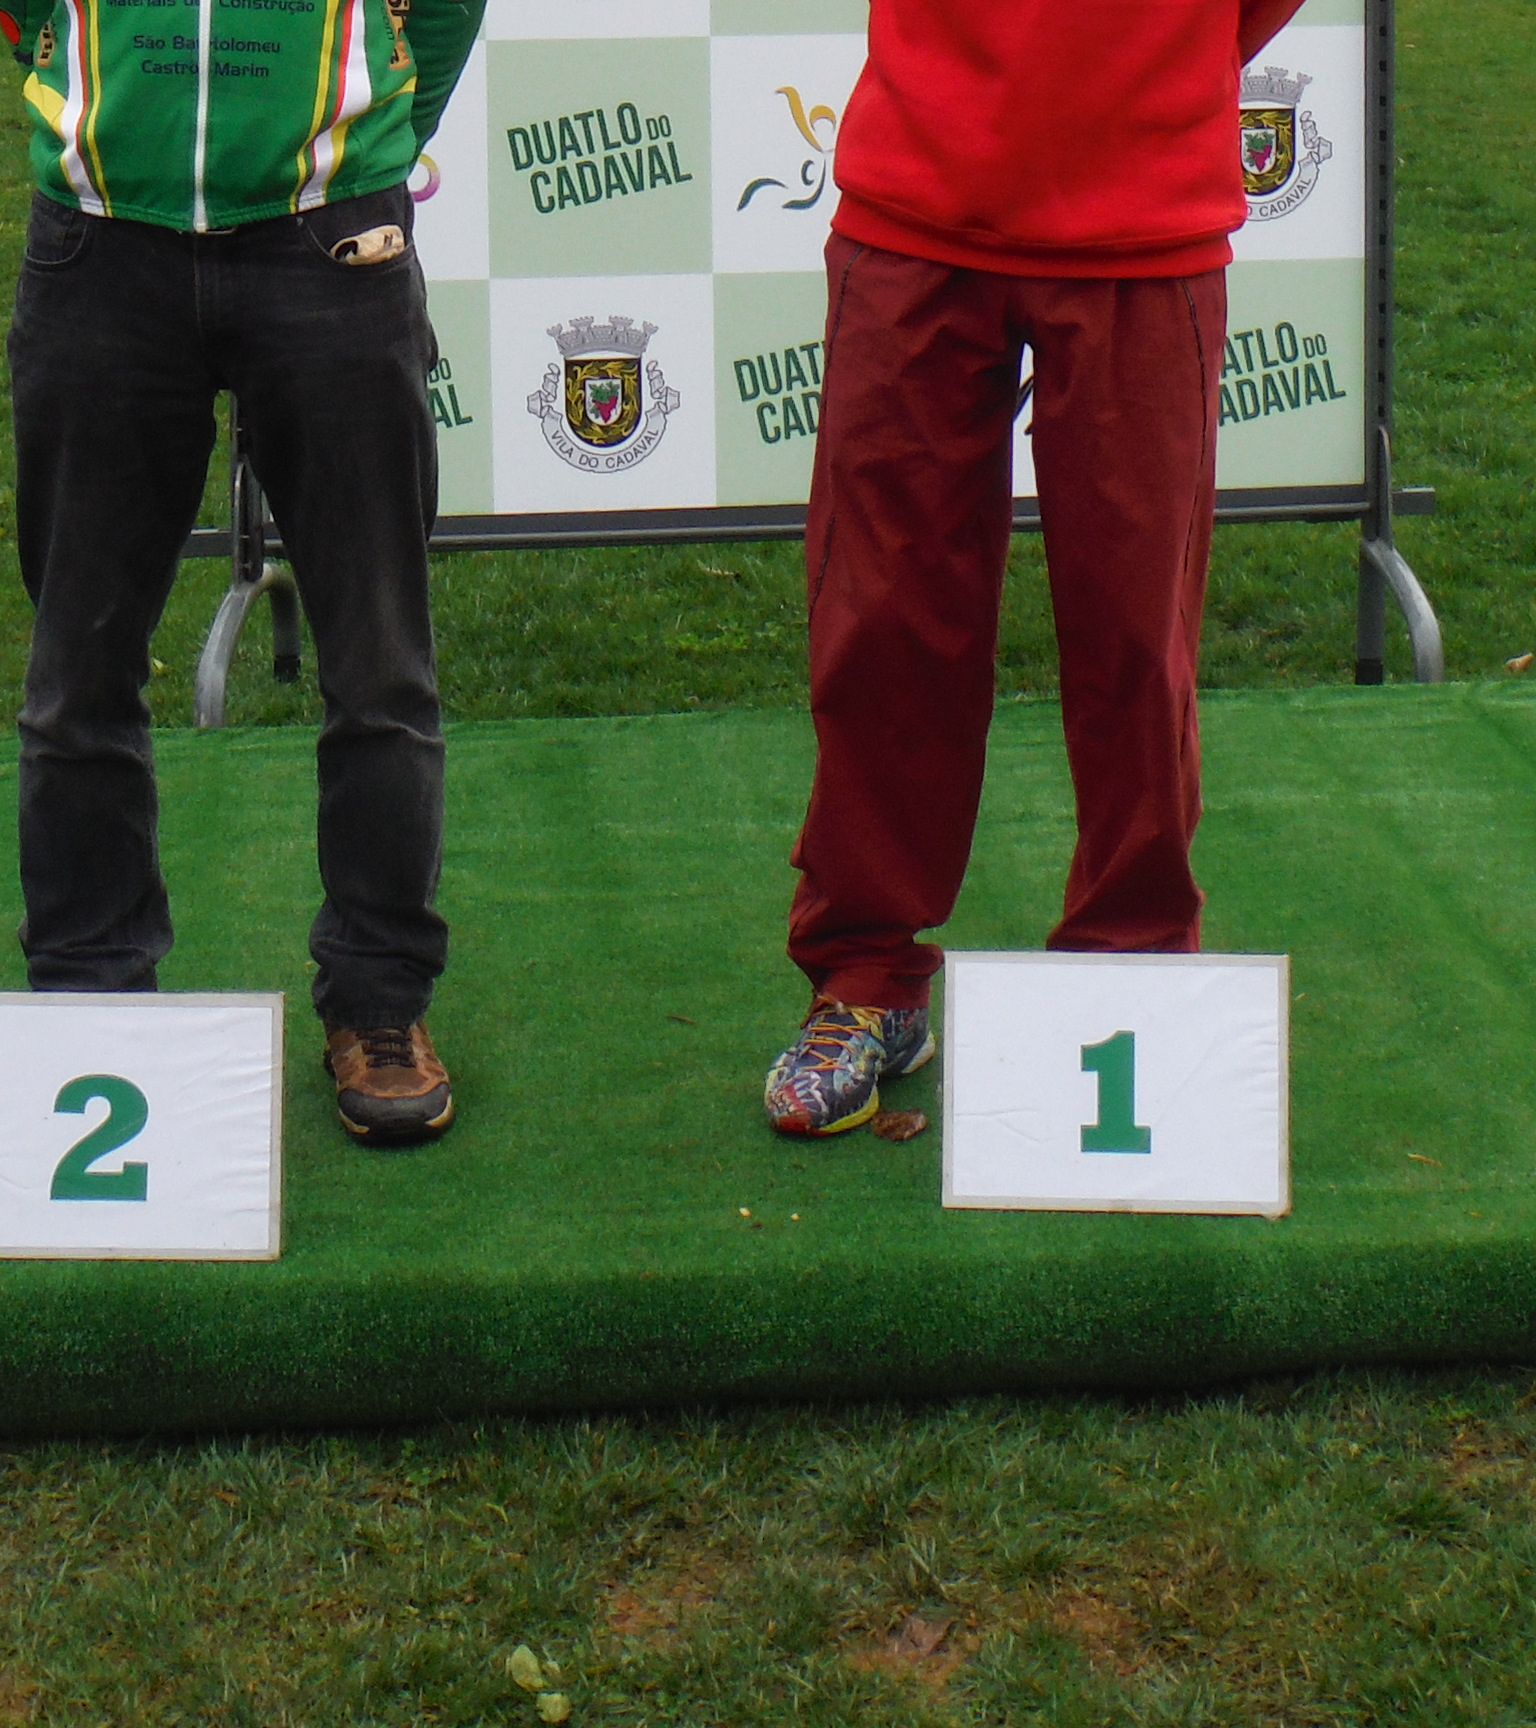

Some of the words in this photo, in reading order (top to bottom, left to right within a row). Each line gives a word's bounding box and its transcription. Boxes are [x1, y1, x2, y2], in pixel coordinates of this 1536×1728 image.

[133, 35, 164, 50] São
[141, 59, 201, 75] Castro
[215, 61, 270, 78] Marim
[507, 102, 642, 170] DUATLO
[645, 114, 673, 141] DO
[529, 141, 694, 214] CADAVAL
[1259, 177, 1312, 218] CADAVAL
[733, 341, 825, 403] DUAT
[1220, 320, 1300, 379] ATLO
[1302, 333, 1328, 358] DO
[756, 391, 821, 445] CAD
[1219, 359, 1347, 427] ADAVAL
[551, 430, 573, 458] VILA
[579, 454, 599, 469] DO
[605, 429, 660, 469] CADAVAL
[1082, 1033, 1151, 1153] 1
[51, 1077, 148, 1201] 2
